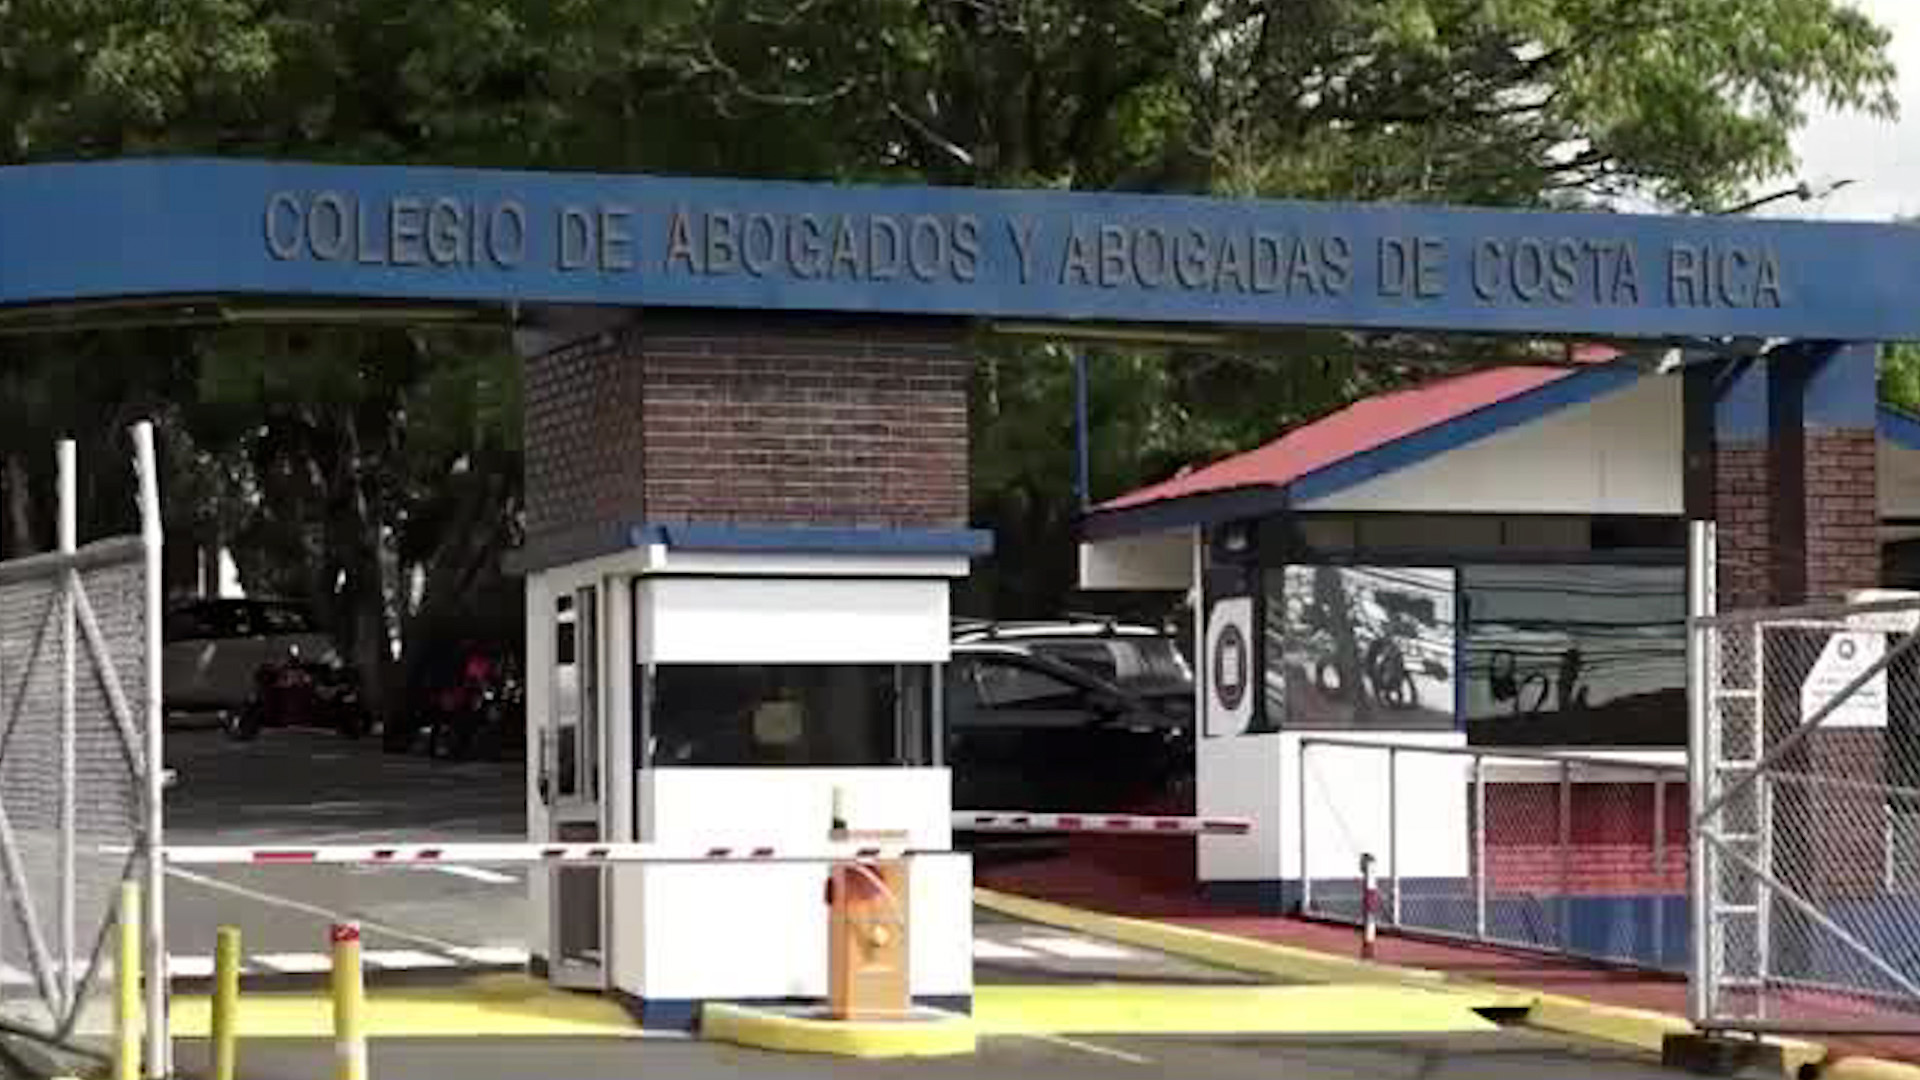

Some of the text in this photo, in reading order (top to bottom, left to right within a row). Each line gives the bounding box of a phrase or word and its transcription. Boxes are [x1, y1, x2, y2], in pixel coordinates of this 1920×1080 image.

[264, 191, 1781, 308] COLEGIO DE ABOGADOS Y ABOGADAS DE COSTA RICA
